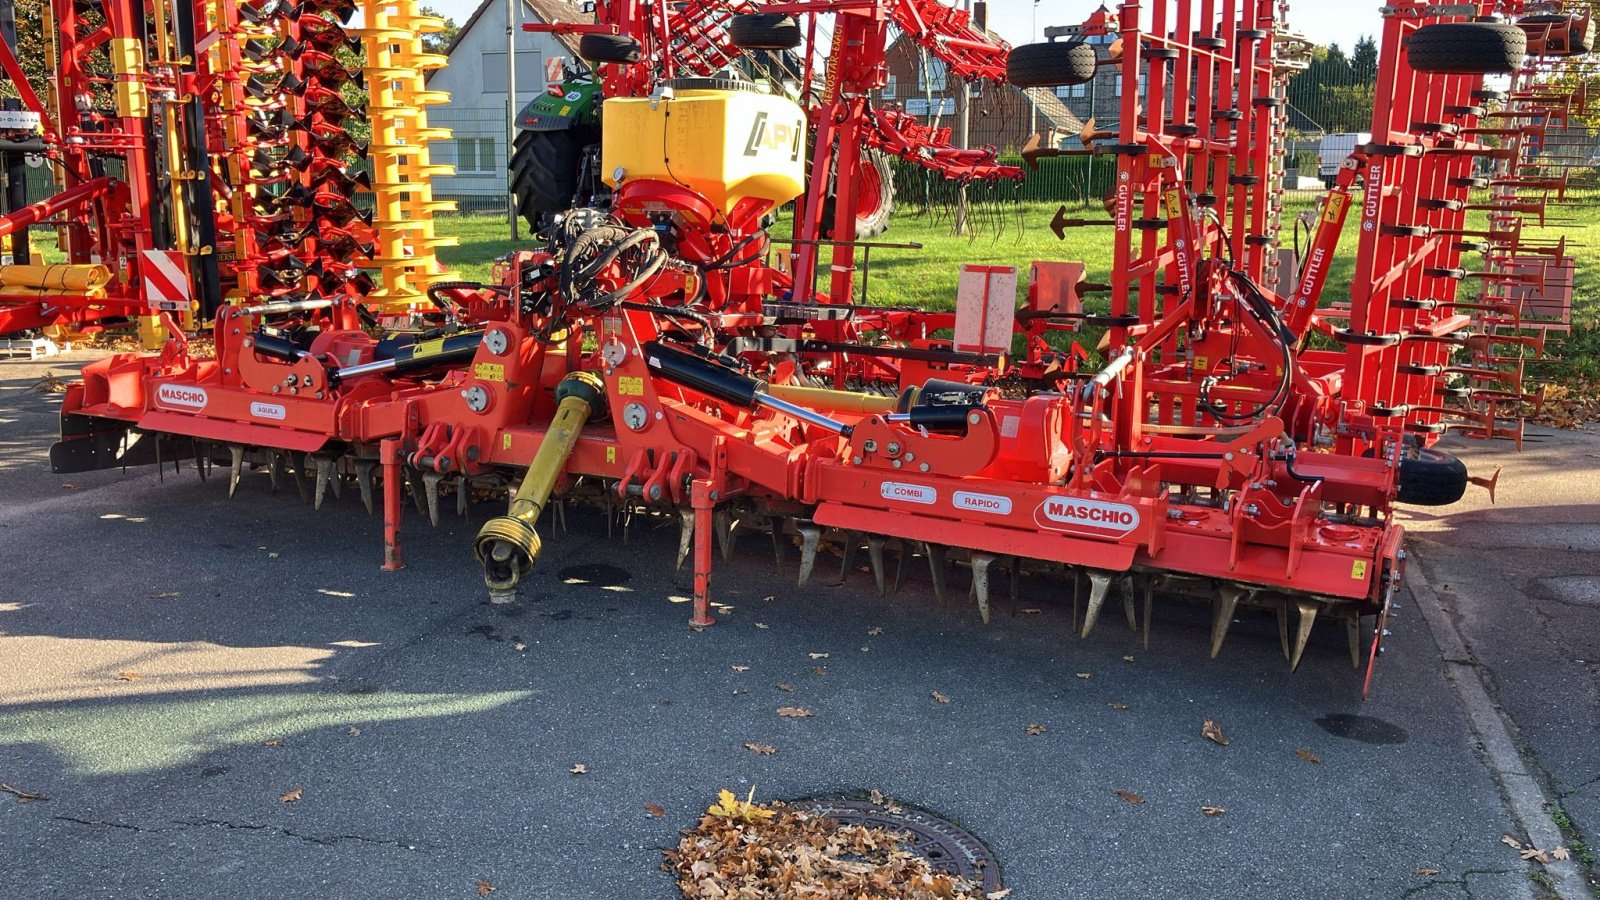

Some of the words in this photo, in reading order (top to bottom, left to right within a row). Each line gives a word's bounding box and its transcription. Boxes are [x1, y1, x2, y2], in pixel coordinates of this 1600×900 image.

[1366, 165, 1381, 217] GÜTTLER
[1117, 184, 1128, 231] GÜTTLER
[1176, 252, 1190, 297] GÜTTLE
[1302, 247, 1326, 295] GÜTTLER
[161, 389, 205, 404] MASCHIO
[257, 406, 278, 415] AQUILA
[894, 487, 923, 498] COMBI
[964, 497, 1000, 509] RAPIDO
[1048, 502, 1134, 525] MASCHIO
